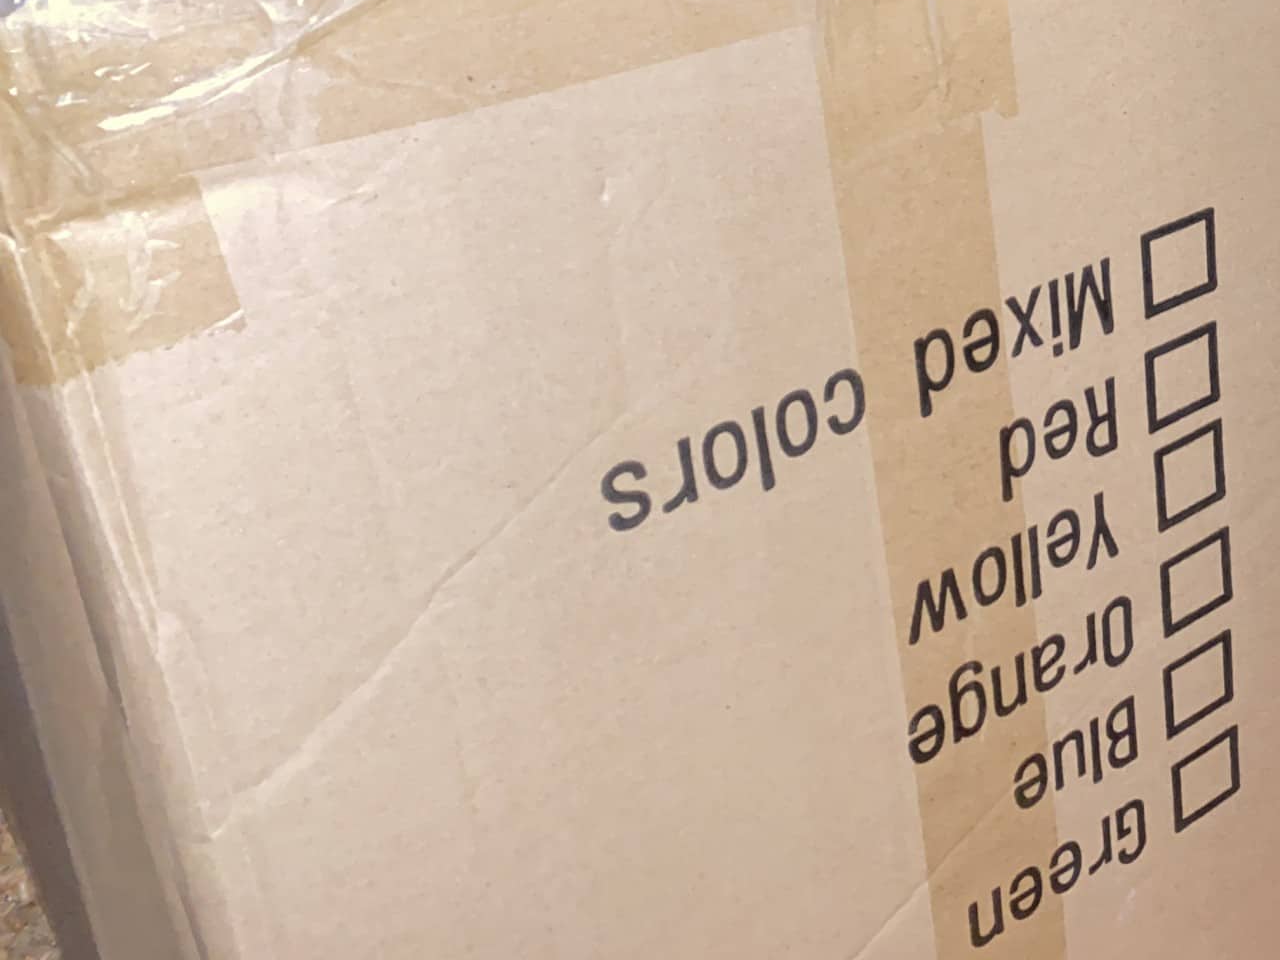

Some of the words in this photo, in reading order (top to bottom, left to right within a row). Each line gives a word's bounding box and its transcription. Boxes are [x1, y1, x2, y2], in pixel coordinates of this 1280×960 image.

[913, 257, 1115, 418] Mixed
[600, 368, 866, 532] colors
[1000, 376, 1119, 502] Red
[908, 492, 1120, 645] Yellow
[907, 596, 1134, 765] Orange
[1013, 695, 1139, 809] Blue
[967, 798, 1146, 948] Green
